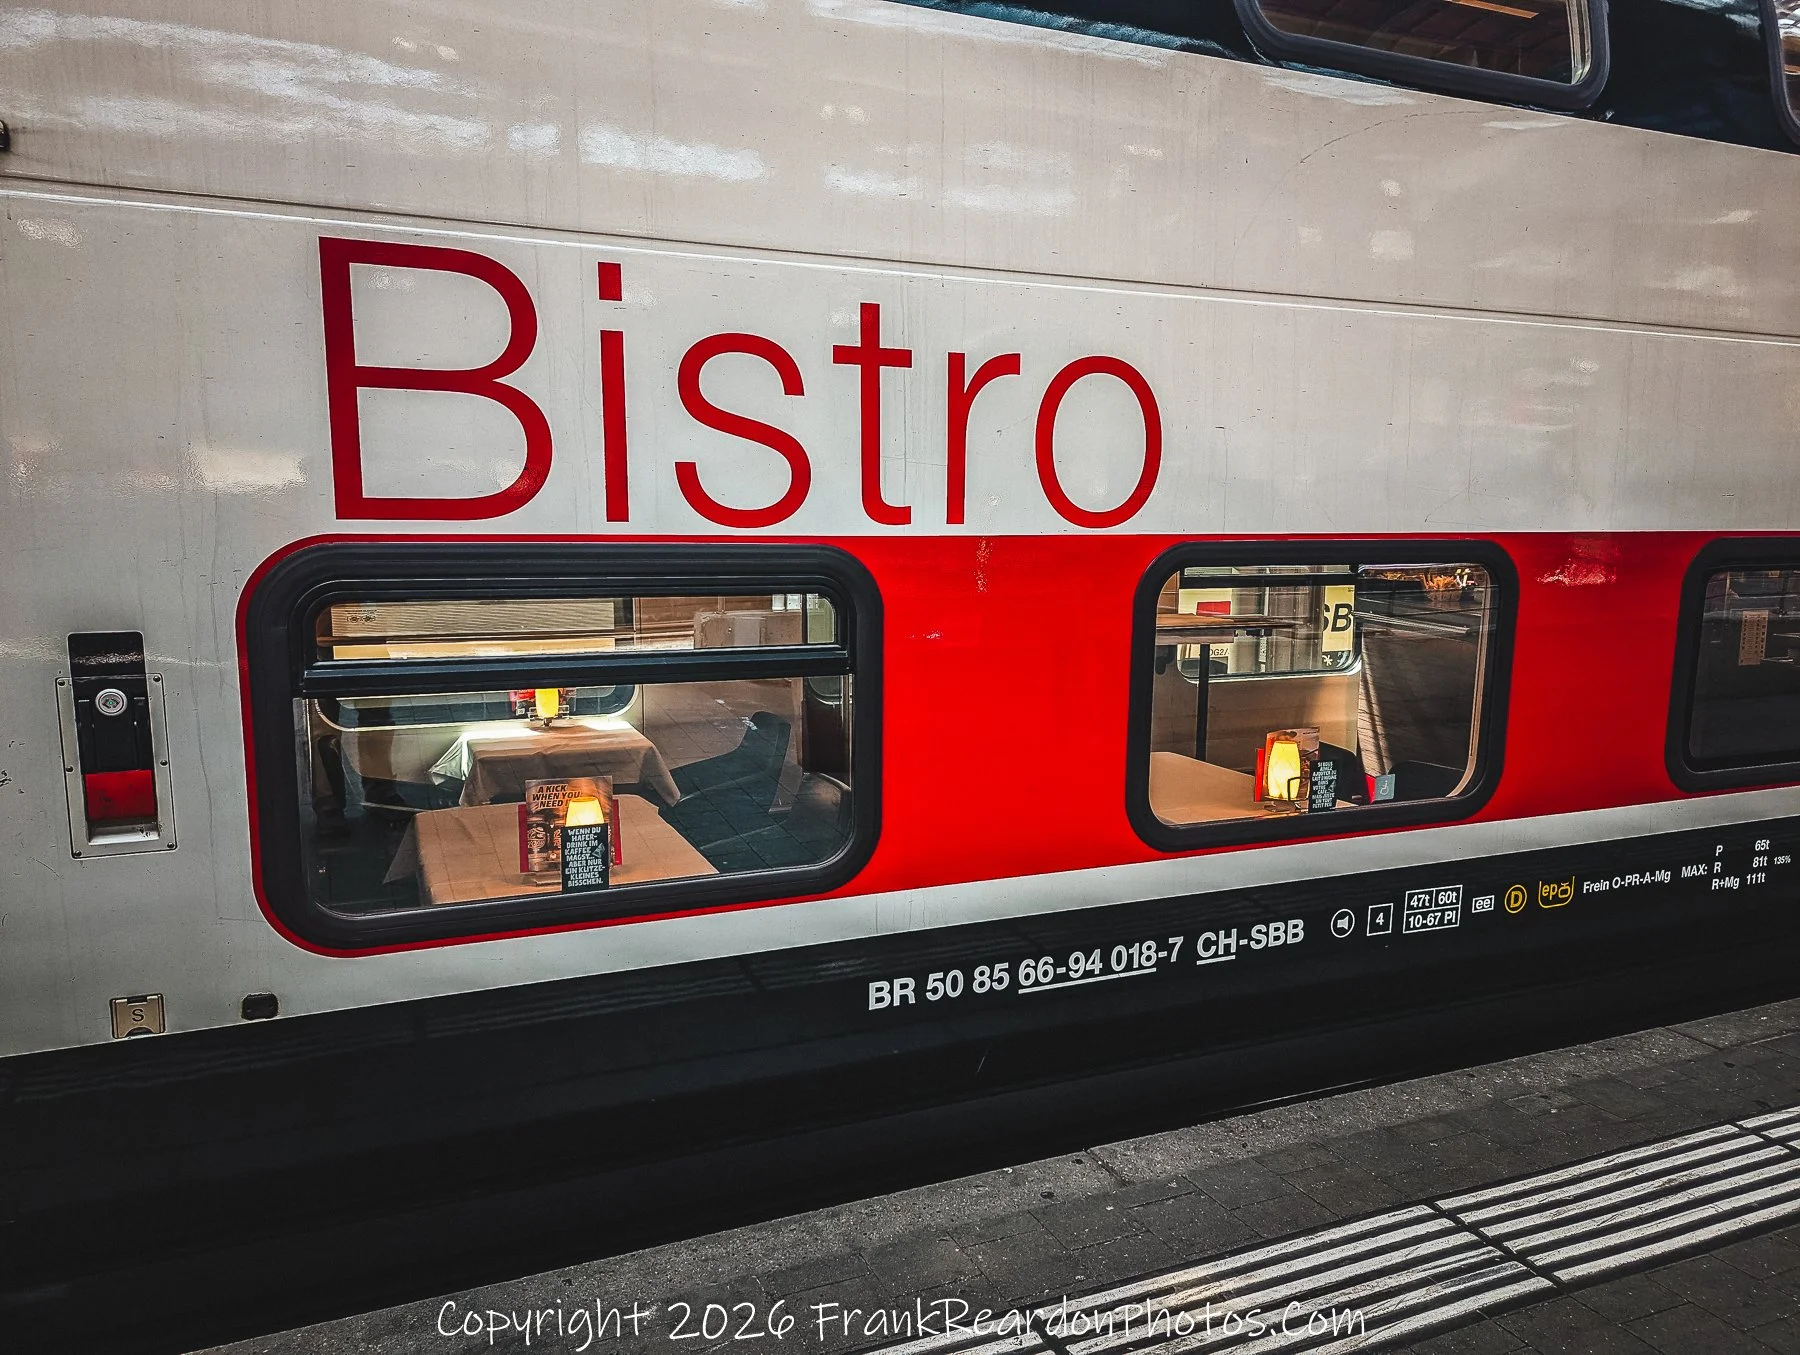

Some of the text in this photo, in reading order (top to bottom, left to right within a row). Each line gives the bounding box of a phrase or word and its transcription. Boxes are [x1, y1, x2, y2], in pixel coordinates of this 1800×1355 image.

[319, 237, 1162, 528] Bistro
[532, 793, 559, 801] WHEN
[567, 841, 587, 849] DRINK
[572, 833, 597, 841] HAFER-
[565, 847, 591, 855] KAFFEE
[1716, 840, 1770, 856] P 65t
[1682, 856, 1791, 878] MAX: R 81t 135%
[570, 872, 599, 880] KLEINES
[1584, 869, 1671, 894] Frein O-PR-A-Mg
[1712, 874, 1765, 890] R+Mg 111t
[1410, 891, 1457, 907] 47t 60t
[1476, 898, 1490, 910] ee
[1510, 891, 1523, 908] D
[1376, 913, 1385, 926] 4
[1408, 913, 1441, 929] 10-67
[869, 918, 1304, 1010] BR 50 85 66-94 018-7 CH-SBB
[132, 1009, 144, 1022] S
